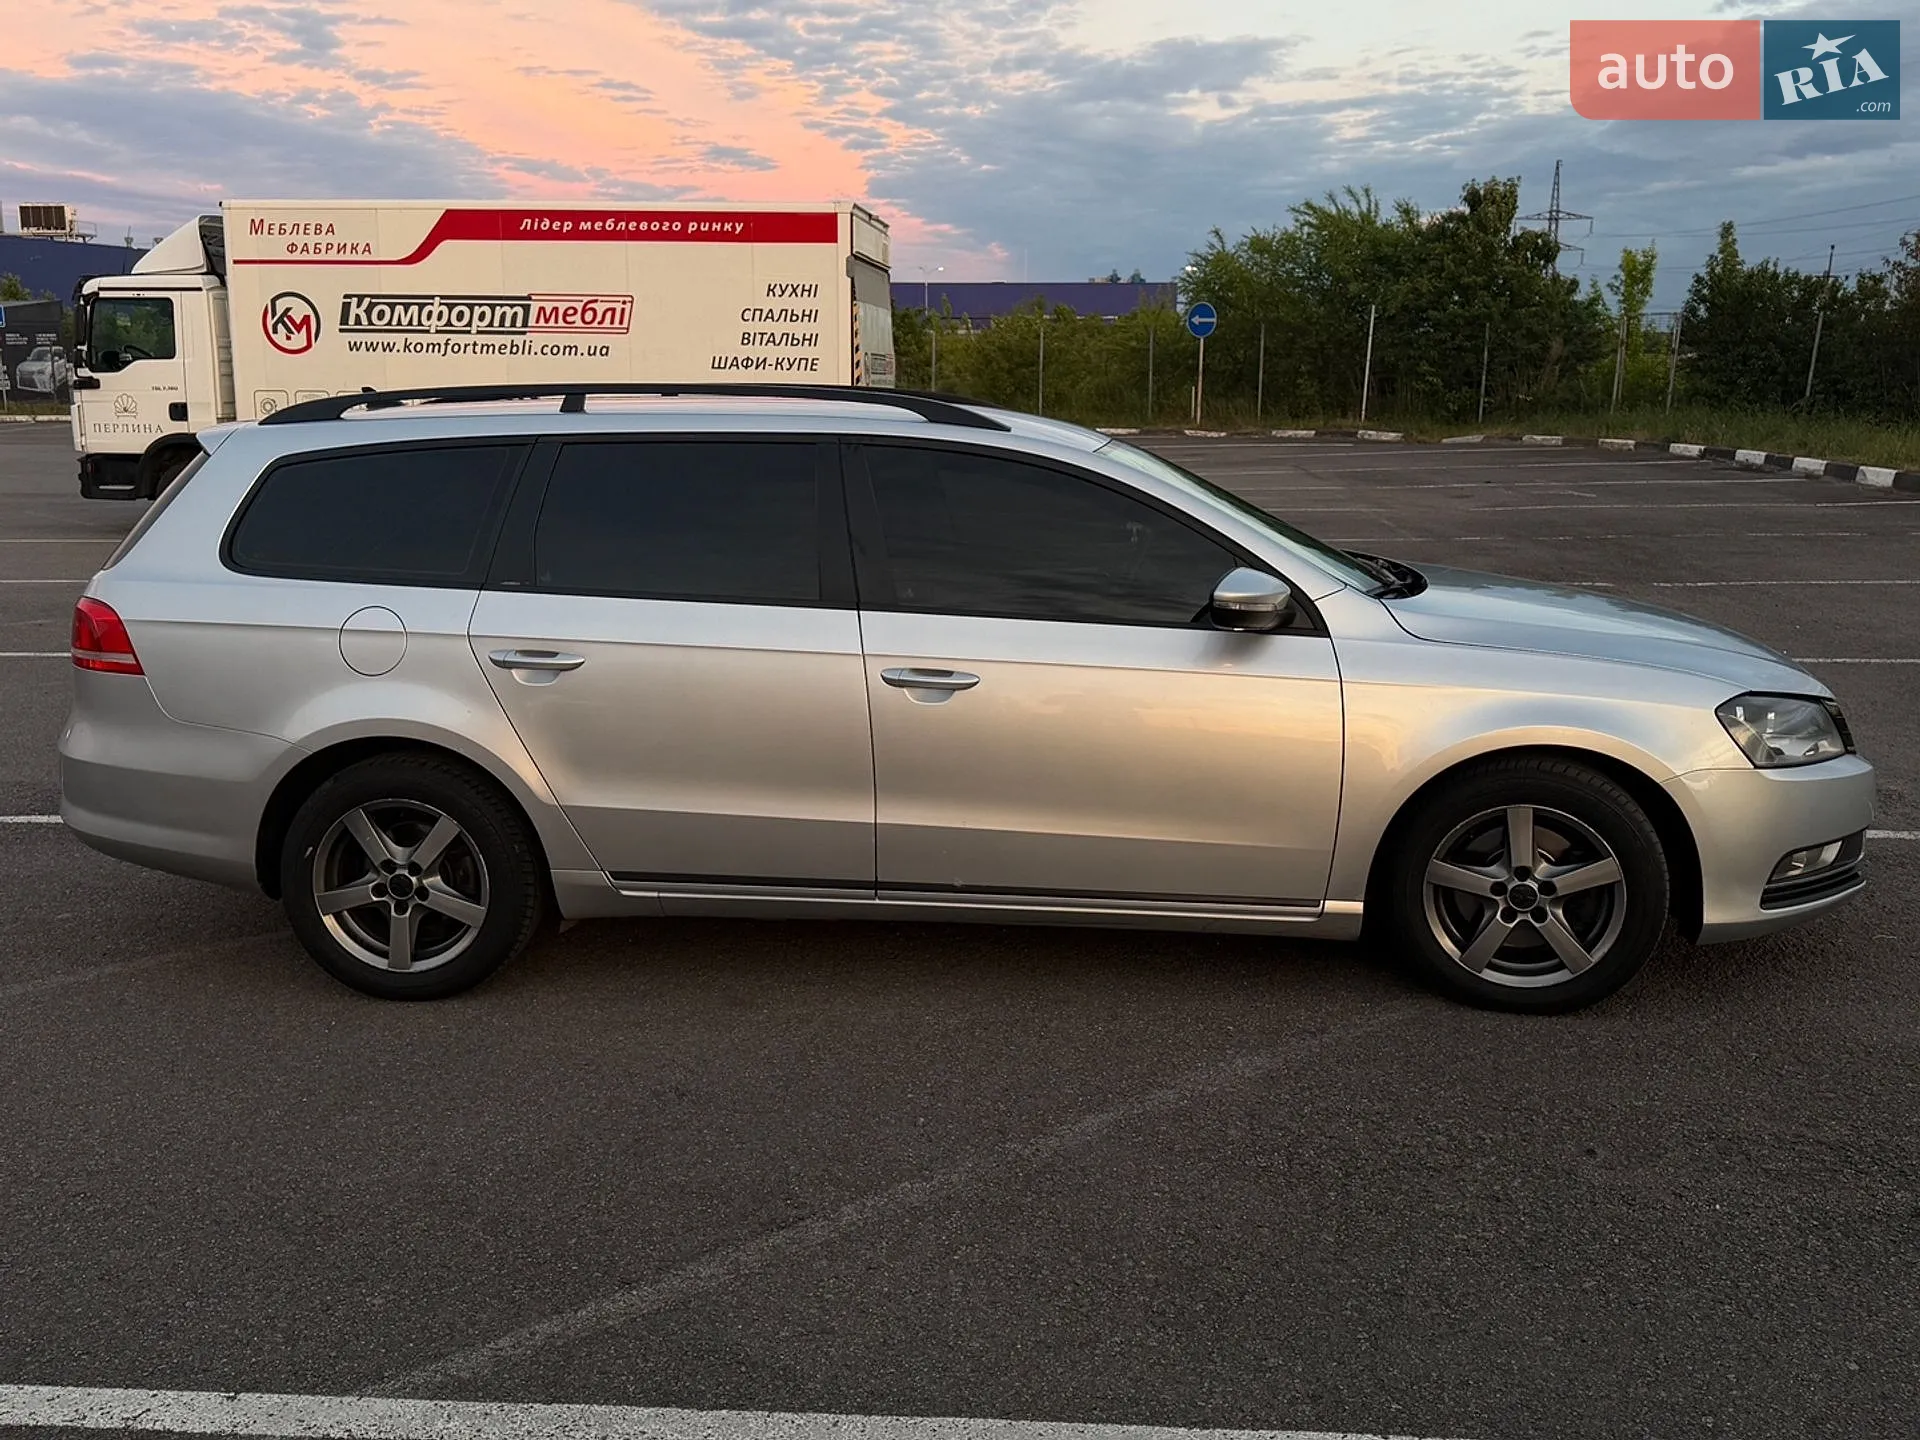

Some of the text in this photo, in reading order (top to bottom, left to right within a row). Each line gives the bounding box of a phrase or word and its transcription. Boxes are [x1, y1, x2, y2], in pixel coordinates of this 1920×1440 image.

[520, 218, 744, 234] Лідер меблевого ринку
[286, 241, 372, 257] ФАБРИКА
[766, 283, 819, 298] КУХНІ
[347, 295, 629, 335] Комфорт меблі
[741, 308, 819, 323] СПАЛЬНІ
[348, 337, 611, 358] www.komfortmebli.com.ua
[740, 332, 819, 347] ВІТАЛЬНІ
[711, 355, 820, 373] ШАФИ-КУПЕ
[93, 422, 164, 434] ПЕРЛИНА
